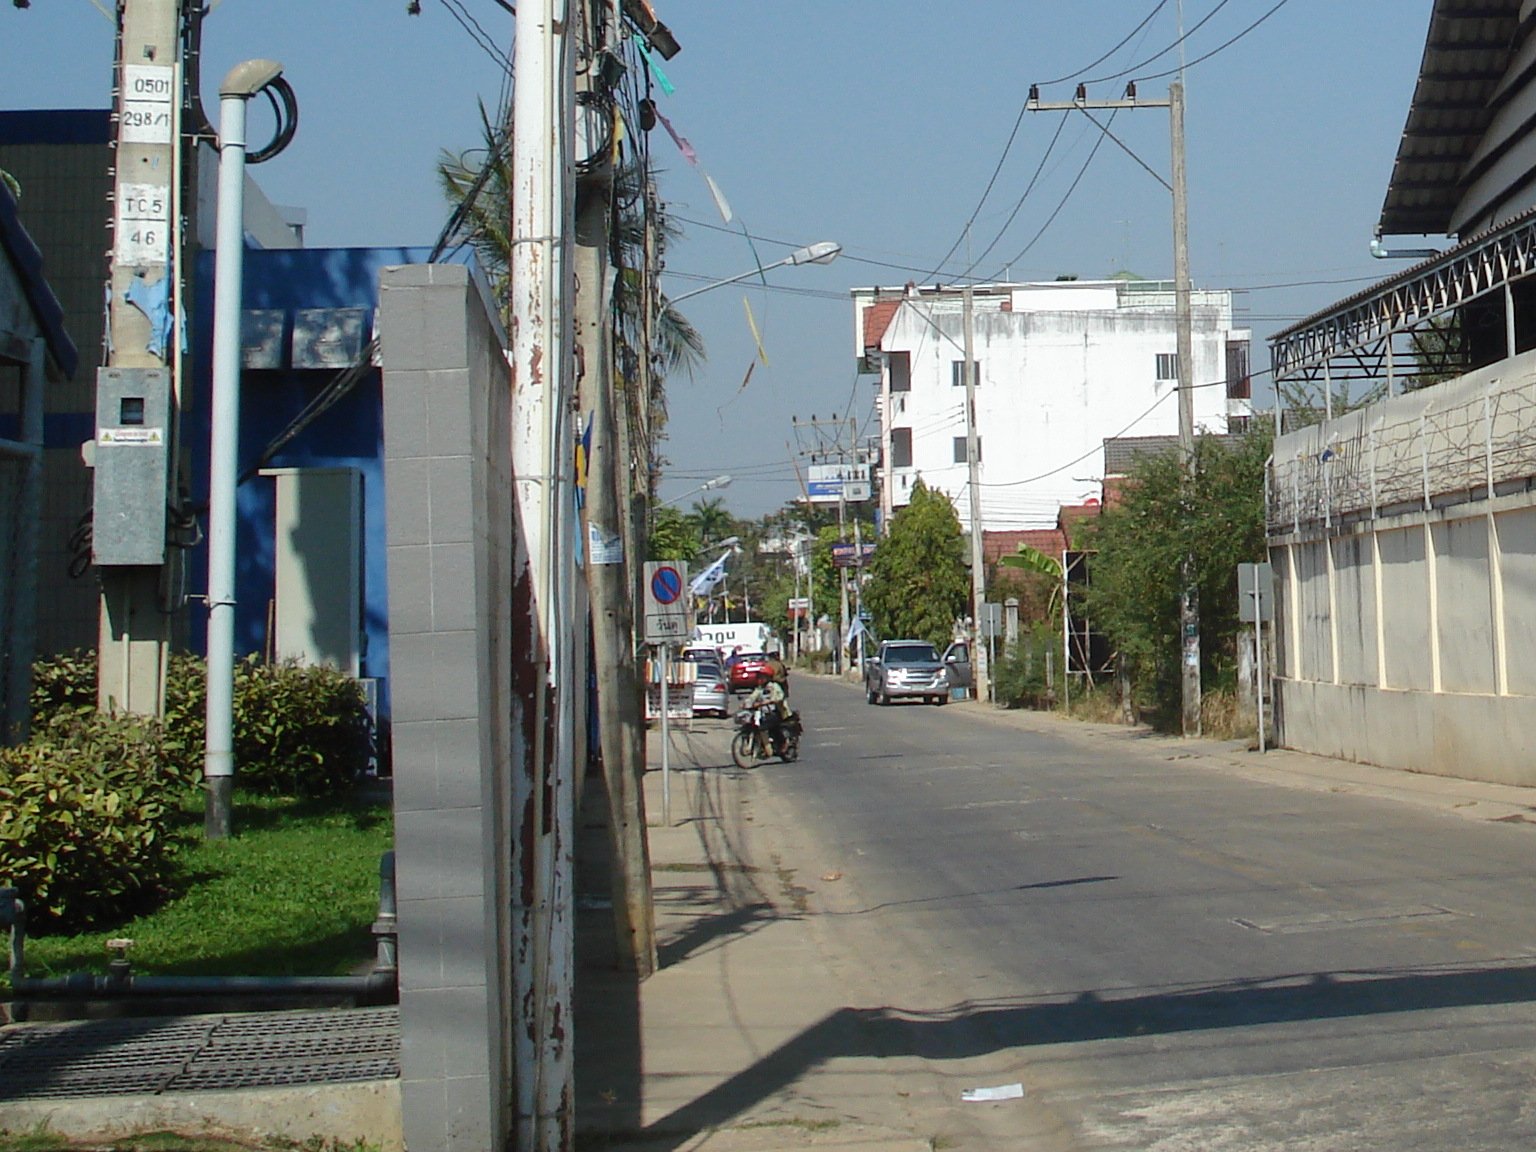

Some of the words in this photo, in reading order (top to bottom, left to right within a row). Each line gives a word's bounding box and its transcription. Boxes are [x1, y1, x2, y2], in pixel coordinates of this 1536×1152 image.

[134, 78, 170, 94] 0501
[123, 110, 169, 127] 298/1
[130, 230, 156, 246] 46
